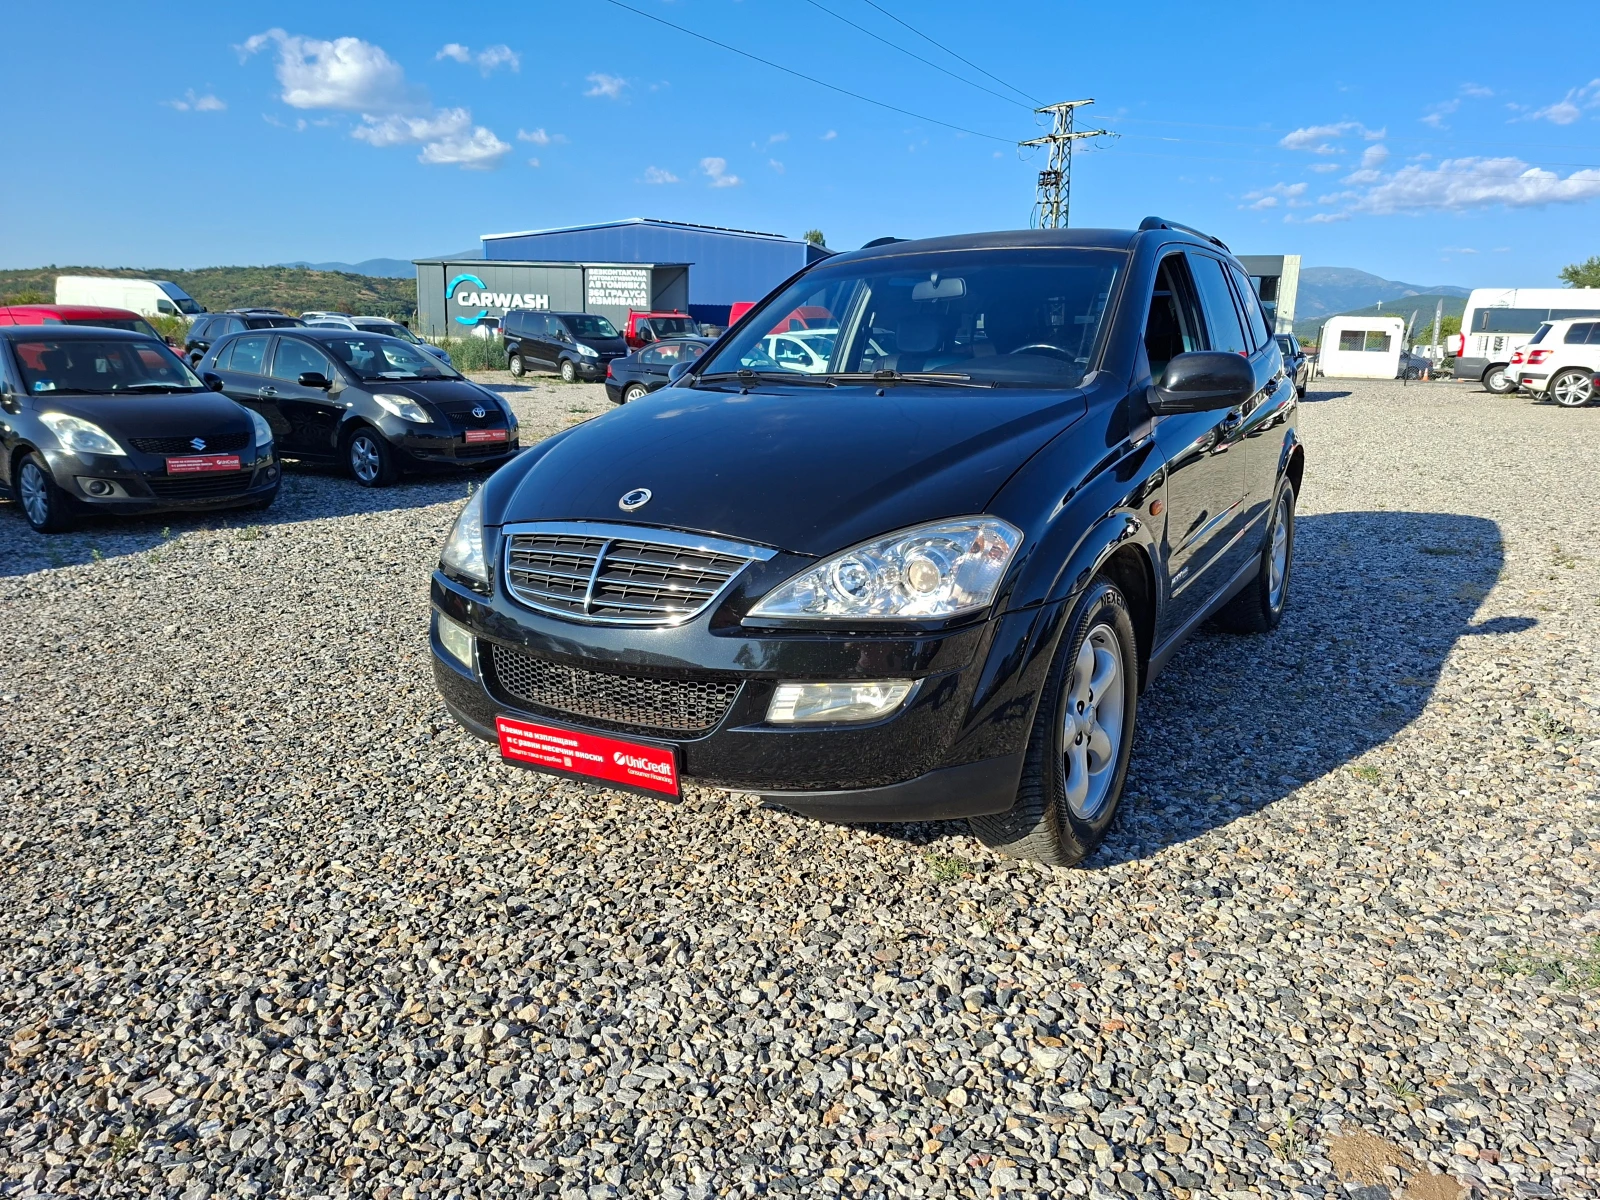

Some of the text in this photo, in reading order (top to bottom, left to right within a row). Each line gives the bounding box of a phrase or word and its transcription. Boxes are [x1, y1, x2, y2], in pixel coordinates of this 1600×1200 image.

[588, 281, 647, 289] АВТОМИВКА
[588, 288, 647, 298] 360 ГРАДУСА
[457, 292, 549, 309] CARWASH
[588, 296, 647, 306] ИЗМИВАНЕ
[500, 724, 523, 736] Вземи
[534, 732, 578, 747] изплащане
[518, 739, 540, 749] равни
[542, 744, 574, 756] месечни
[574, 750, 604, 762] вноски
[626, 754, 672, 776] UniCredit
[628, 768, 672, 784] Consumer Financing
